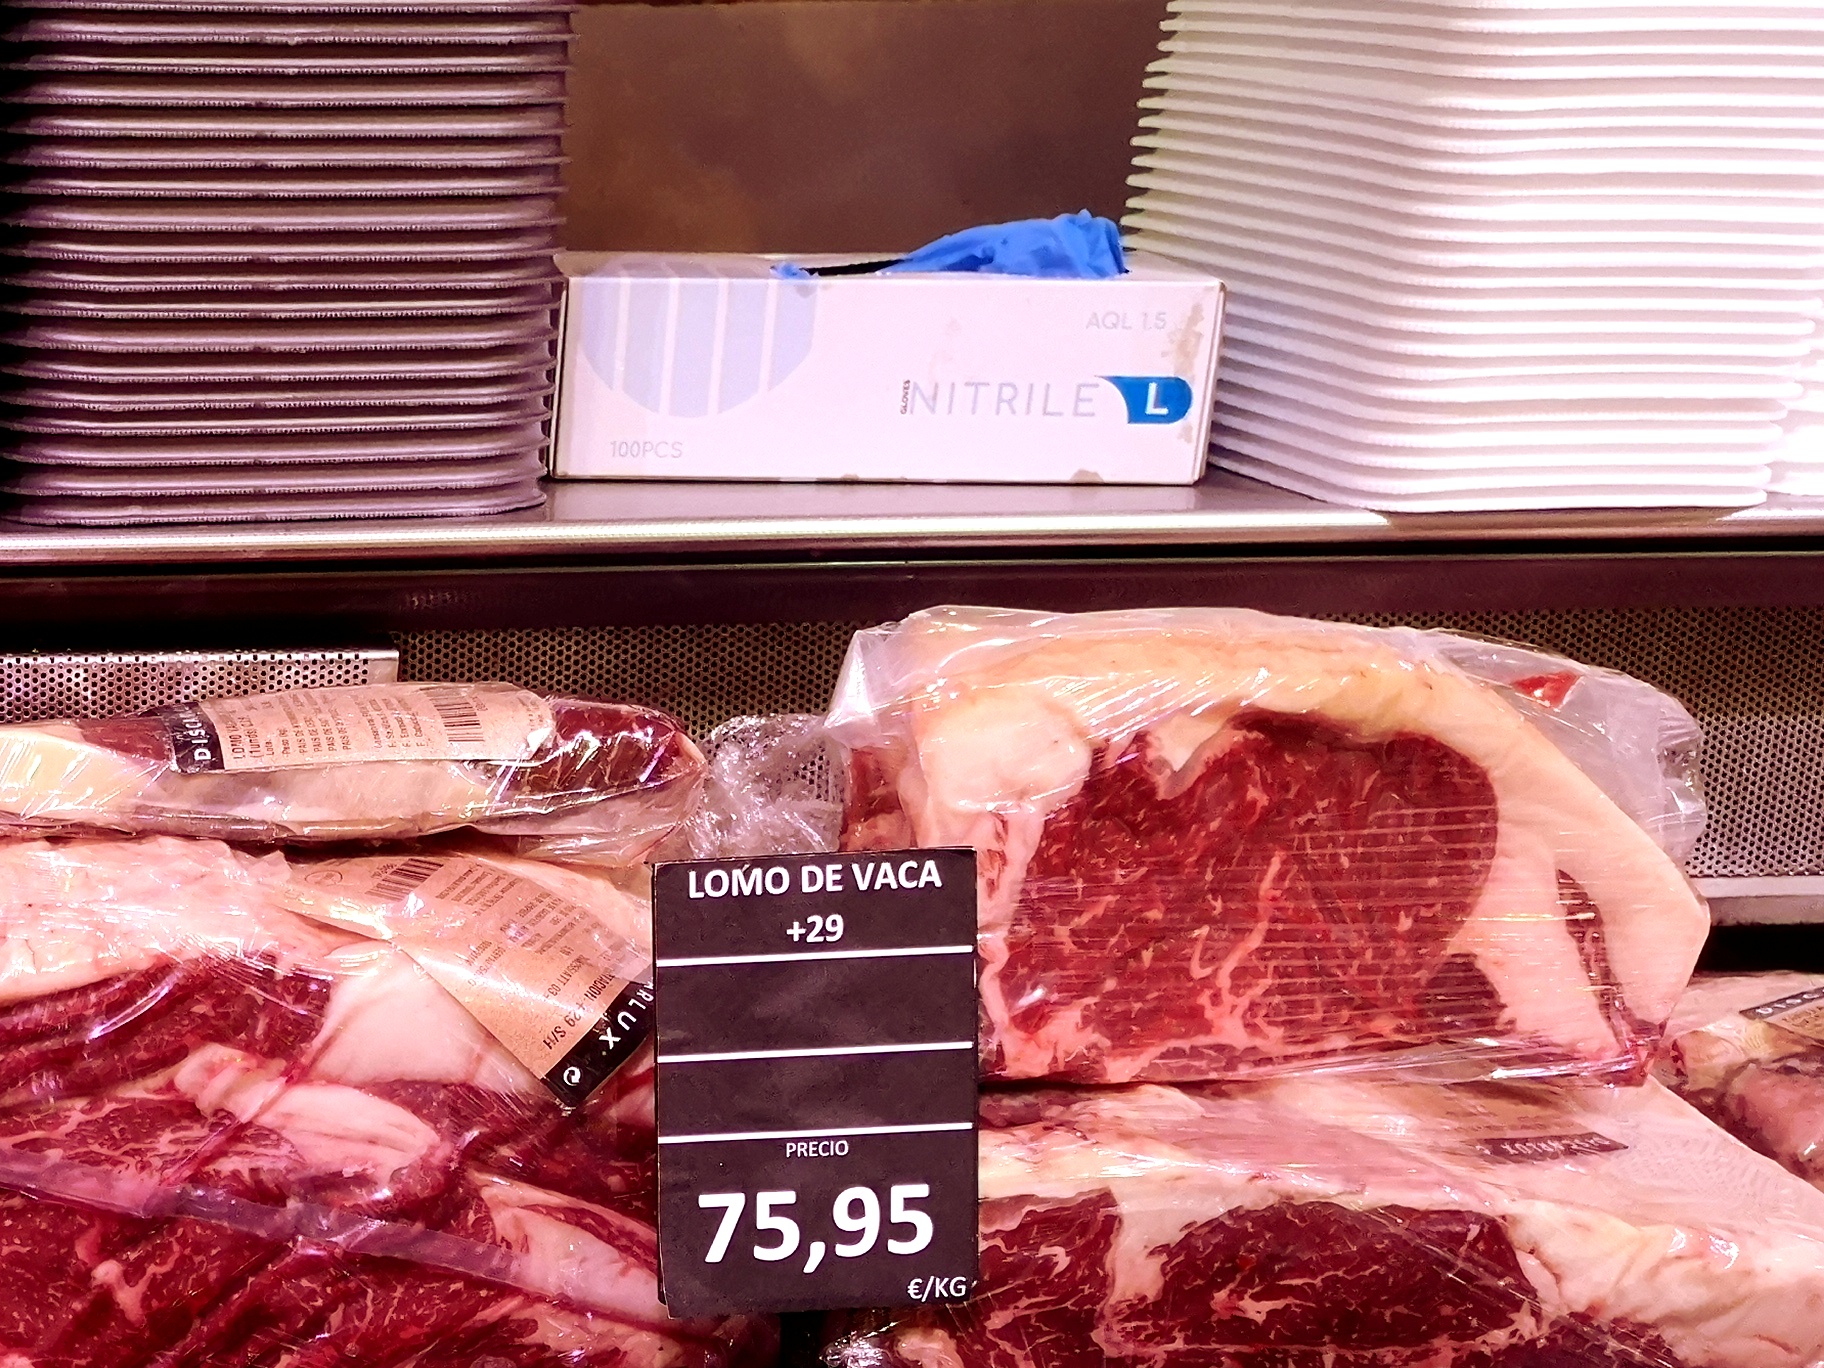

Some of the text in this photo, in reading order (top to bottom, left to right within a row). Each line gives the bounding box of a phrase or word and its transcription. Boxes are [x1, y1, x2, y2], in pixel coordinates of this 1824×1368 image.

[1085, 310, 1168, 332] AQL 1.5
[908, 381, 1099, 419] NITRILE
[1144, 381, 1170, 416] L
[609, 440, 684, 460] 100PCS
[687, 857, 944, 901] LOMO DE VACA
[785, 913, 846, 946] +29
[784, 1138, 850, 1161] PRECIO
[697, 1181, 935, 1275] 75,95
[906, 1274, 968, 1301] €/KG
